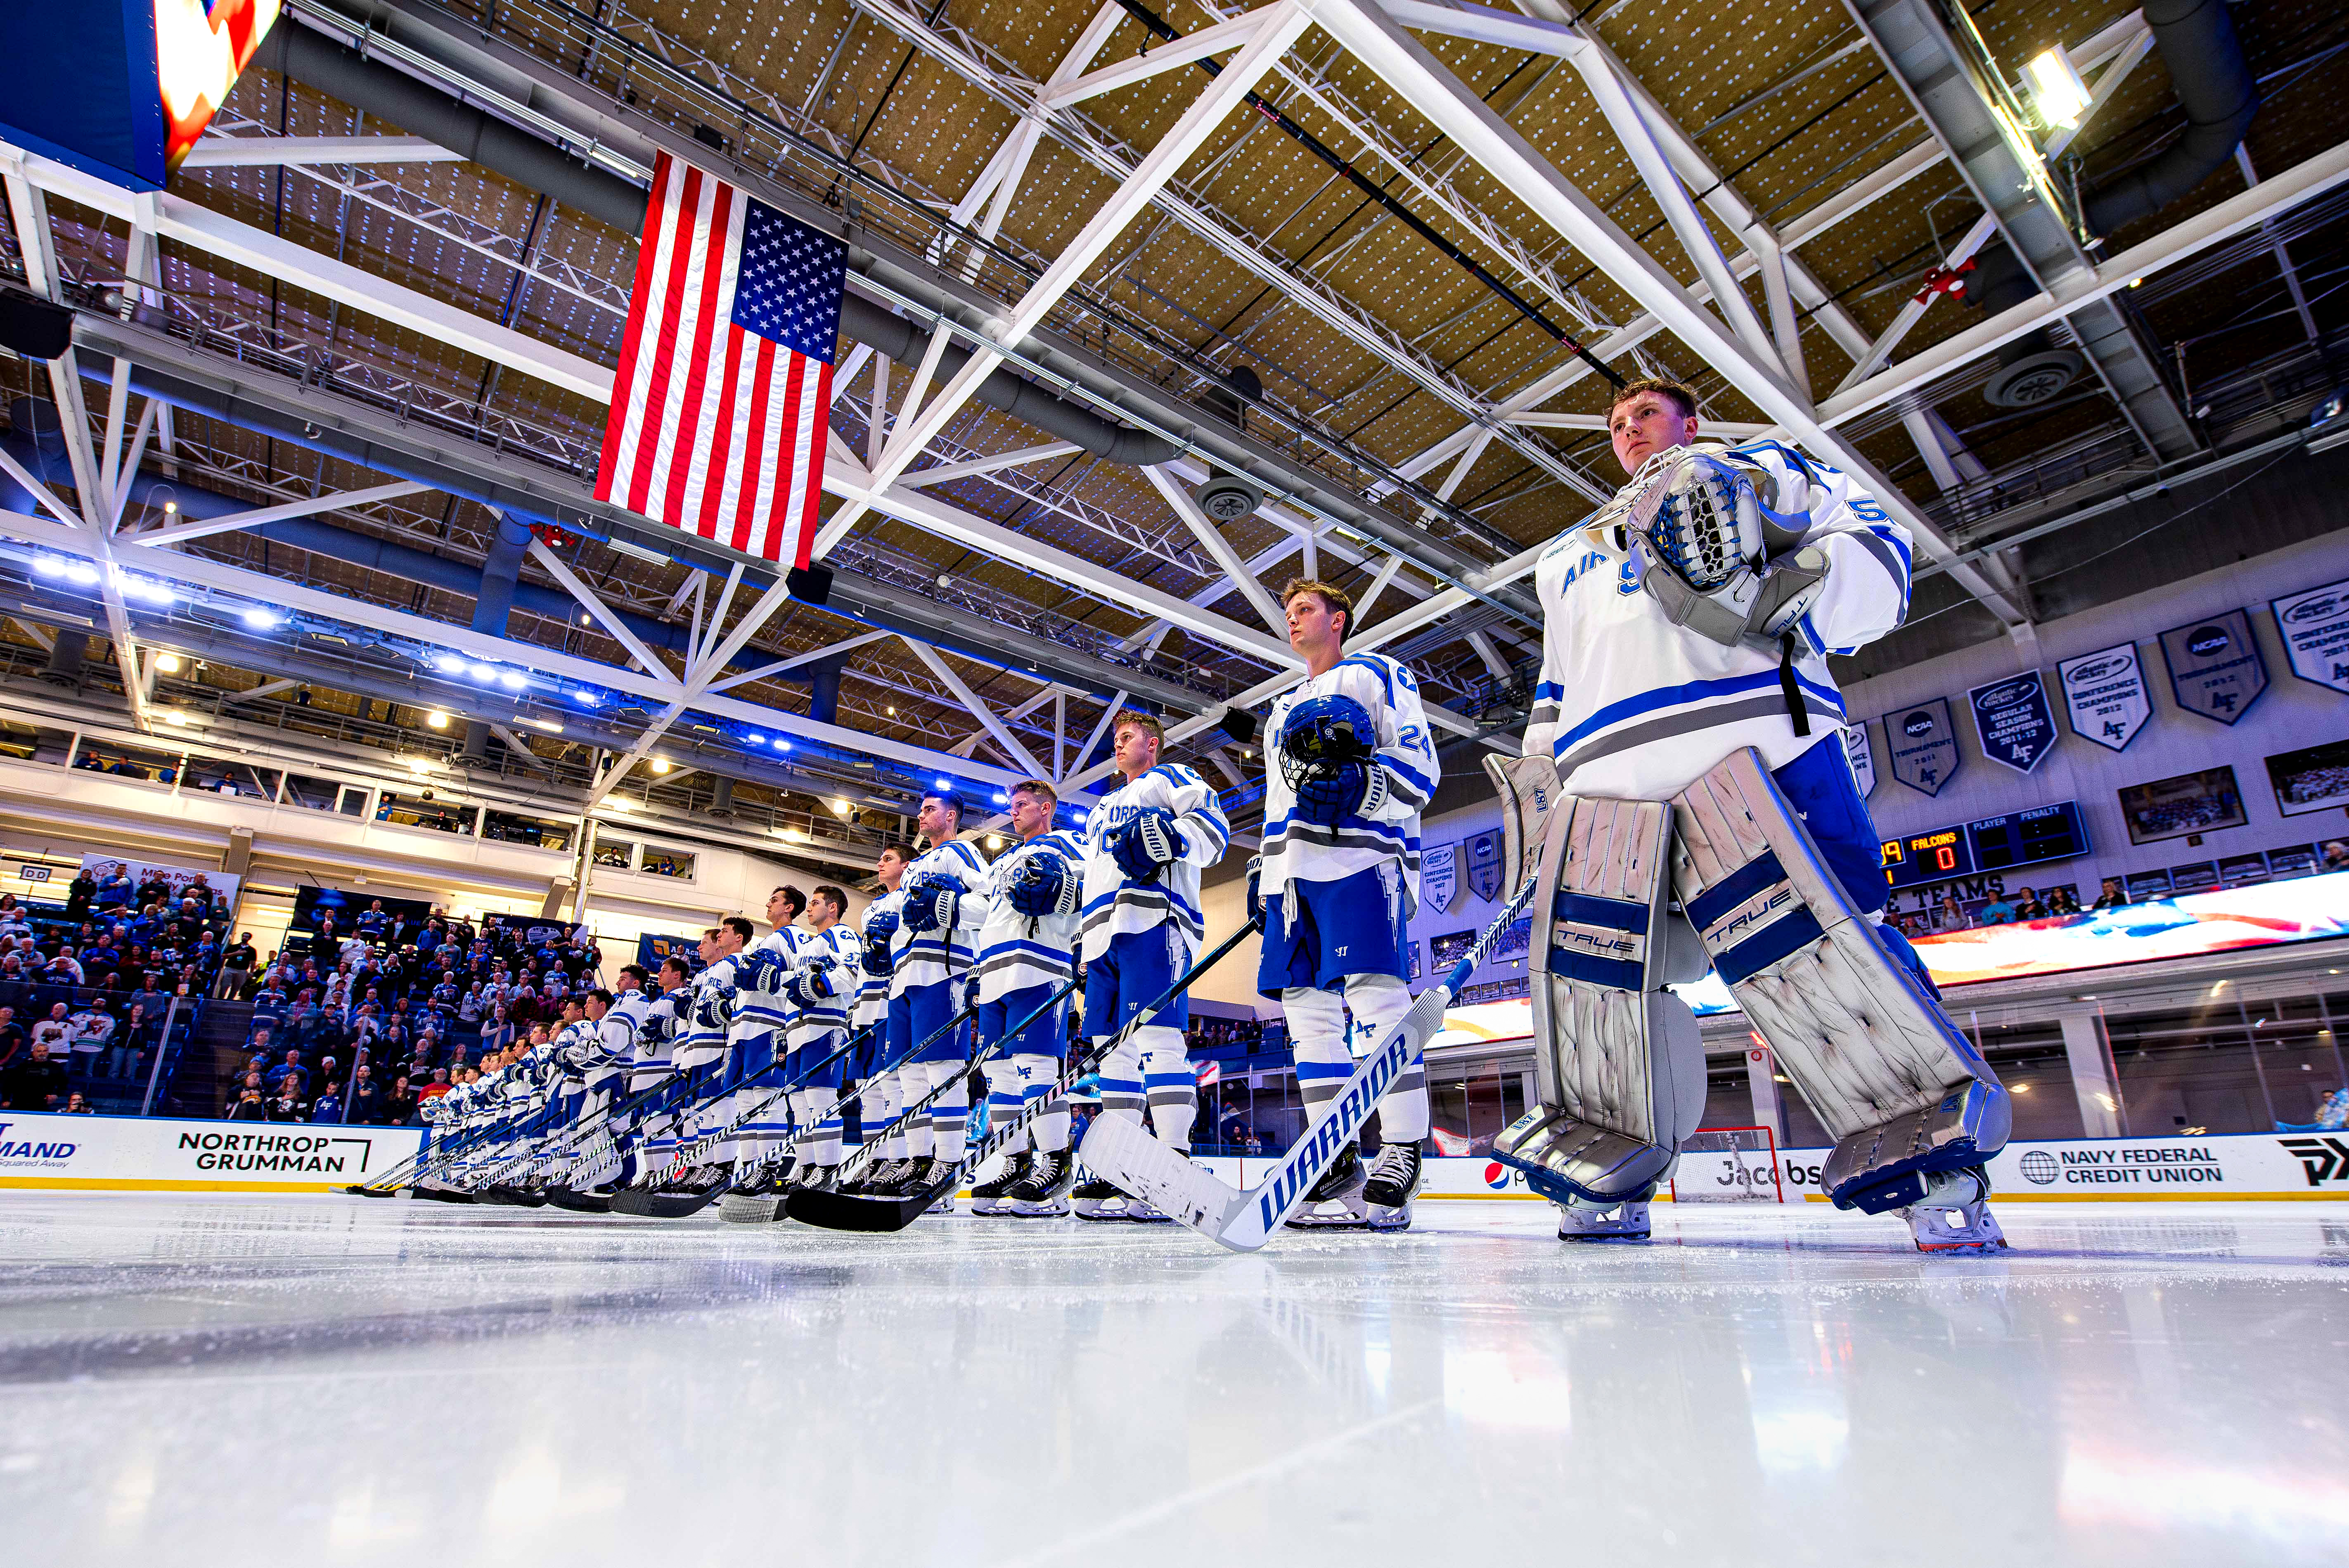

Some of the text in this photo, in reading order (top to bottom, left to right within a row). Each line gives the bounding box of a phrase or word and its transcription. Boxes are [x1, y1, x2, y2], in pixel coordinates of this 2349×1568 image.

[1908, 721, 1933, 734] NCAA
[1989, 719, 2044, 739] CHAMPIONS
[2103, 721, 2126, 739] AF
[1398, 724, 1432, 763] 24
[2012, 744, 2033, 763] AF
[1920, 768, 1937, 785] AF
[1534, 789, 1549, 813] L87
[2021, 806, 2060, 821] PENALTY
[1974, 818, 2006, 830] PLAYER
[1143, 815, 1166, 858] ARRIOR
[1911, 833, 1956, 851] FALCONS
[1477, 845, 1492, 854] NCAA
[1937, 847, 1955, 870] 0
[142, 868, 170, 879] Mie
[1425, 867, 1453, 877] CONFERENCE
[1426, 874, 1452, 883] CHAMPIONS
[1436, 893, 1446, 906] AF
[1913, 875, 2005, 908] TEAMS
[1707, 888, 1790, 943] TRUE
[1557, 930, 1636, 952] TRUE
[320, 1100, 332, 1110] AF
[955, 1068, 1078, 1184] WARRIOR
[1510, 1113, 1536, 1130] L87
[178, 1132, 329, 1153] NORTHROP
[831, 1095, 935, 1184] WARRIOR
[1261, 1033, 1409, 1235] WARRIOR
[40, 1160, 70, 1169] Away
[197, 1152, 345, 1172] GRUMMAN
[2060, 1148, 2218, 1163] NAVY FEDERAL
[1717, 1159, 1821, 1186] Jacobs
[2065, 1168, 2223, 1184] CREDIT UNION
[1045, 1182, 1061, 1196] BAUER
[1319, 1174, 1344, 1192] BAUER
